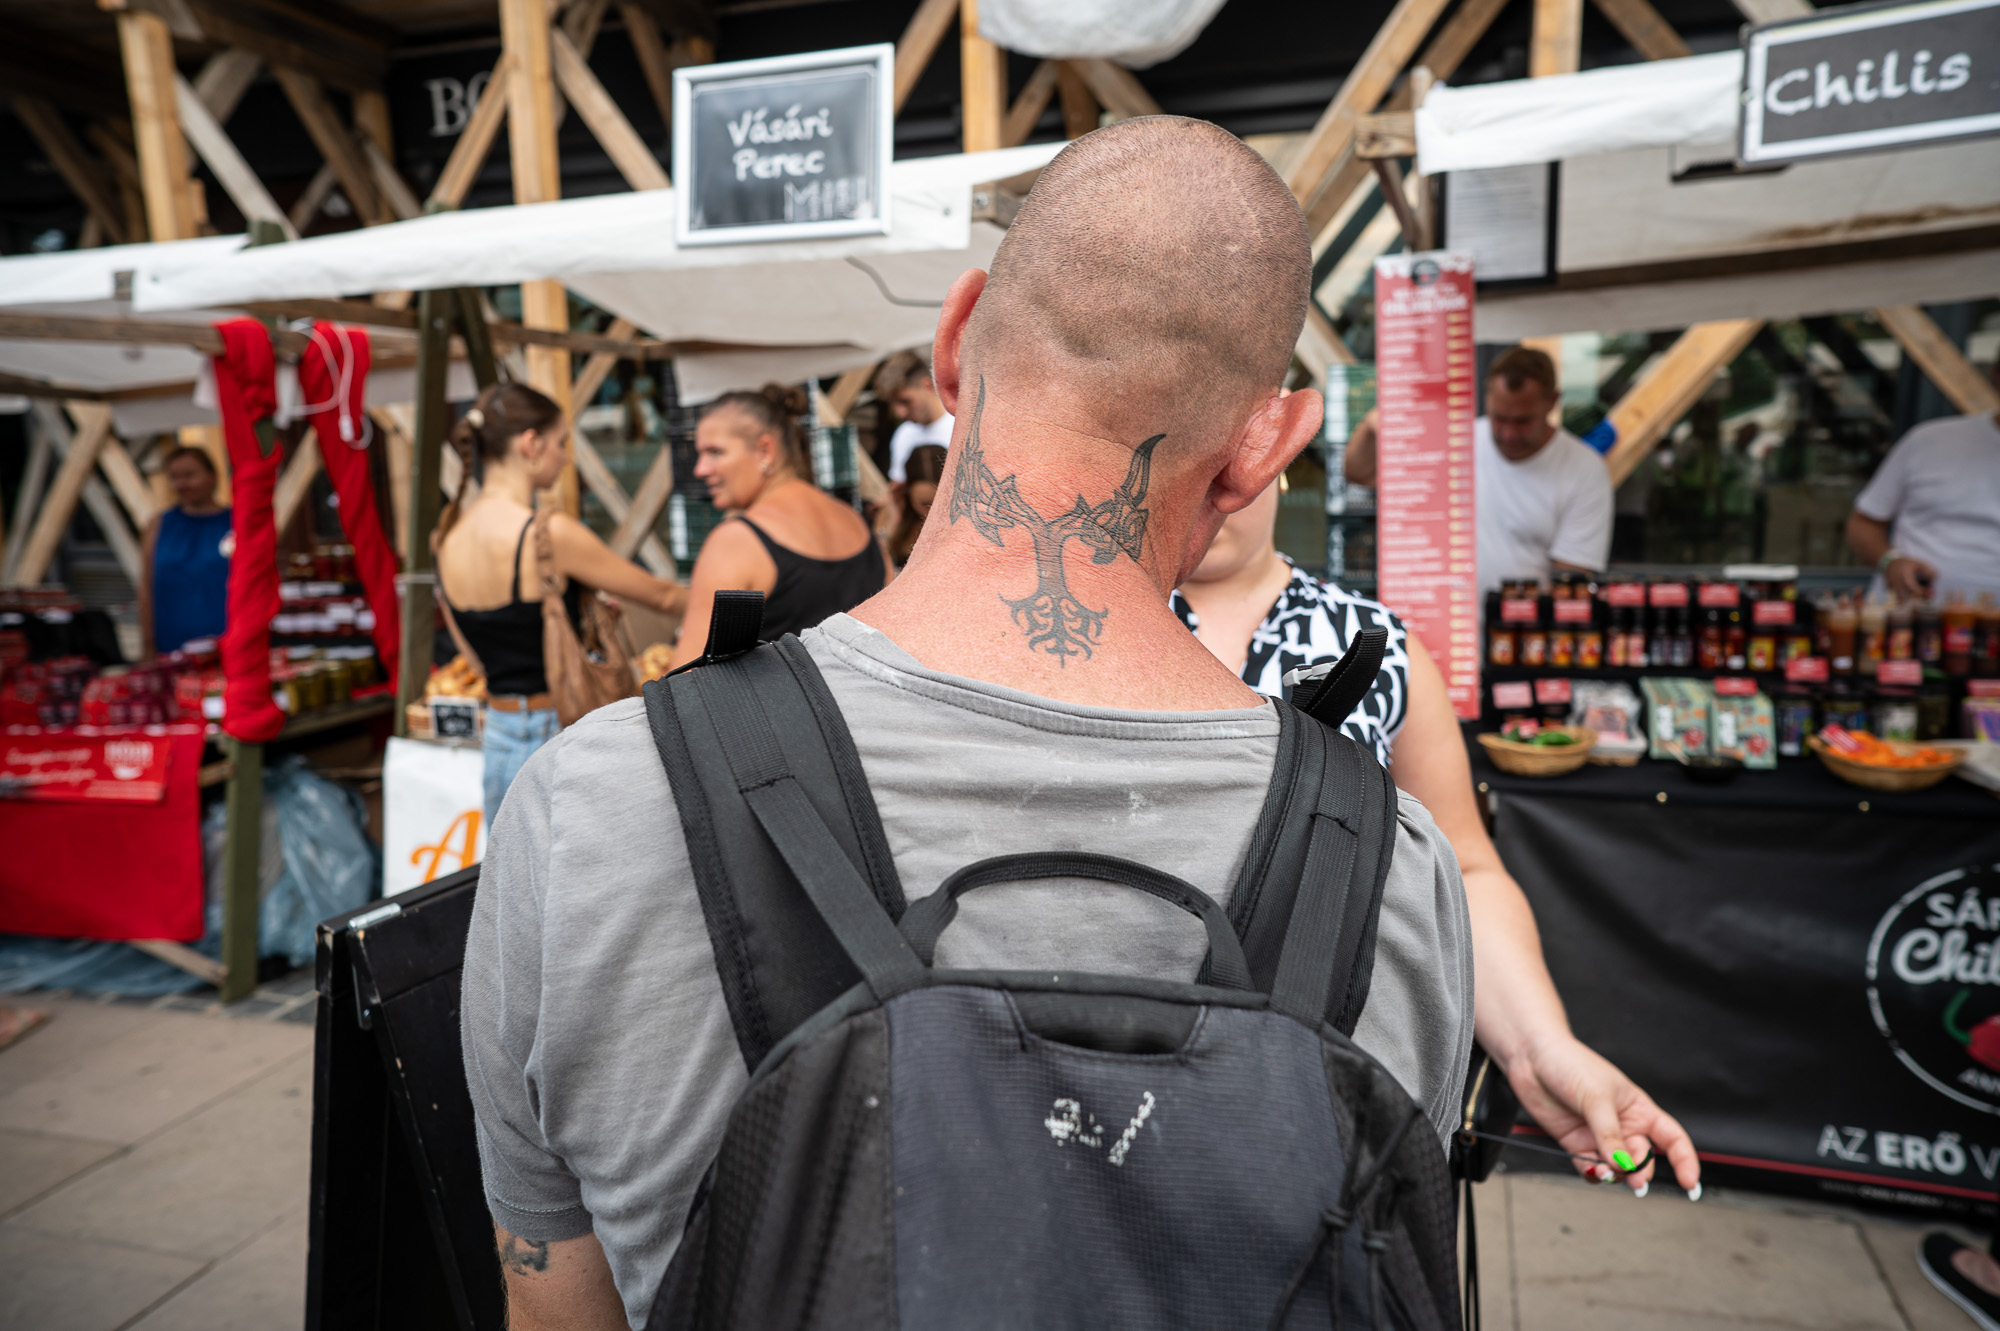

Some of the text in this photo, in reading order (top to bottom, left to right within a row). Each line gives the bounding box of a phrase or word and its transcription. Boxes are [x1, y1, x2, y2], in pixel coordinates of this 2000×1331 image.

[1765, 49, 1972, 116] Chilis
[727, 102, 833, 147] Vásári
[732, 148, 825, 181] Perec
[1815, 1123, 1870, 1164] AZ
[1874, 1130, 1967, 1176] ERŐ
